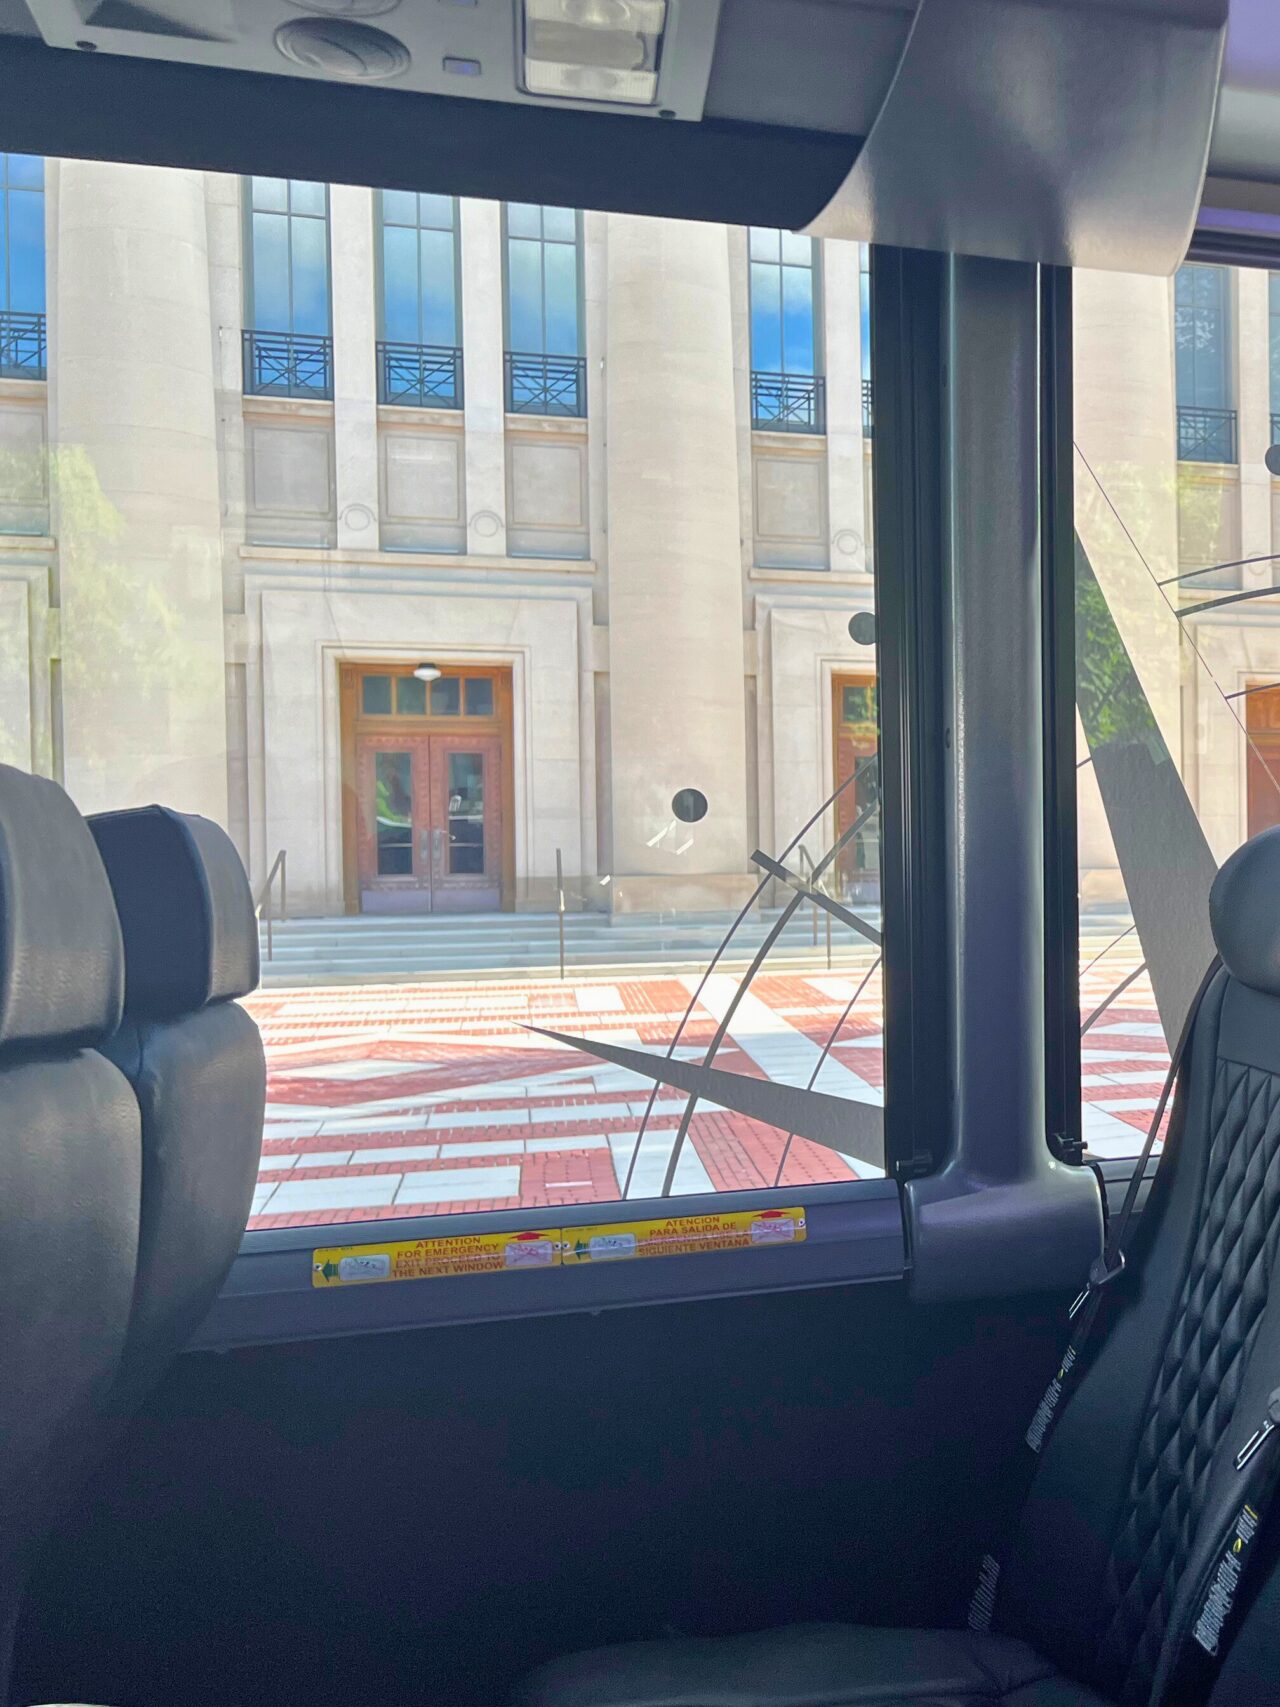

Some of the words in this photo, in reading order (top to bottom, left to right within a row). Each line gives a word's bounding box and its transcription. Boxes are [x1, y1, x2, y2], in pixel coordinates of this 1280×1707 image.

[649, 1228, 678, 1237] PARA
[681, 1224, 720, 1234] SALIDA
[722, 1221, 736, 1230] DE
[666, 1216, 720, 1227] ATENCION
[416, 1237, 481, 1249] ATTENTION
[639, 1243, 696, 1256] SIGUIENTE
[699, 1238, 750, 1249] VENTANA
[398, 1251, 421, 1259] FOR
[425, 1244, 499, 1257] EMERGENCY
[393, 1269, 415, 1278] THE
[420, 1265, 449, 1275] NEXT
[453, 1261, 504, 1273] WINDOW
[396, 1259, 421, 1268] EXIT
